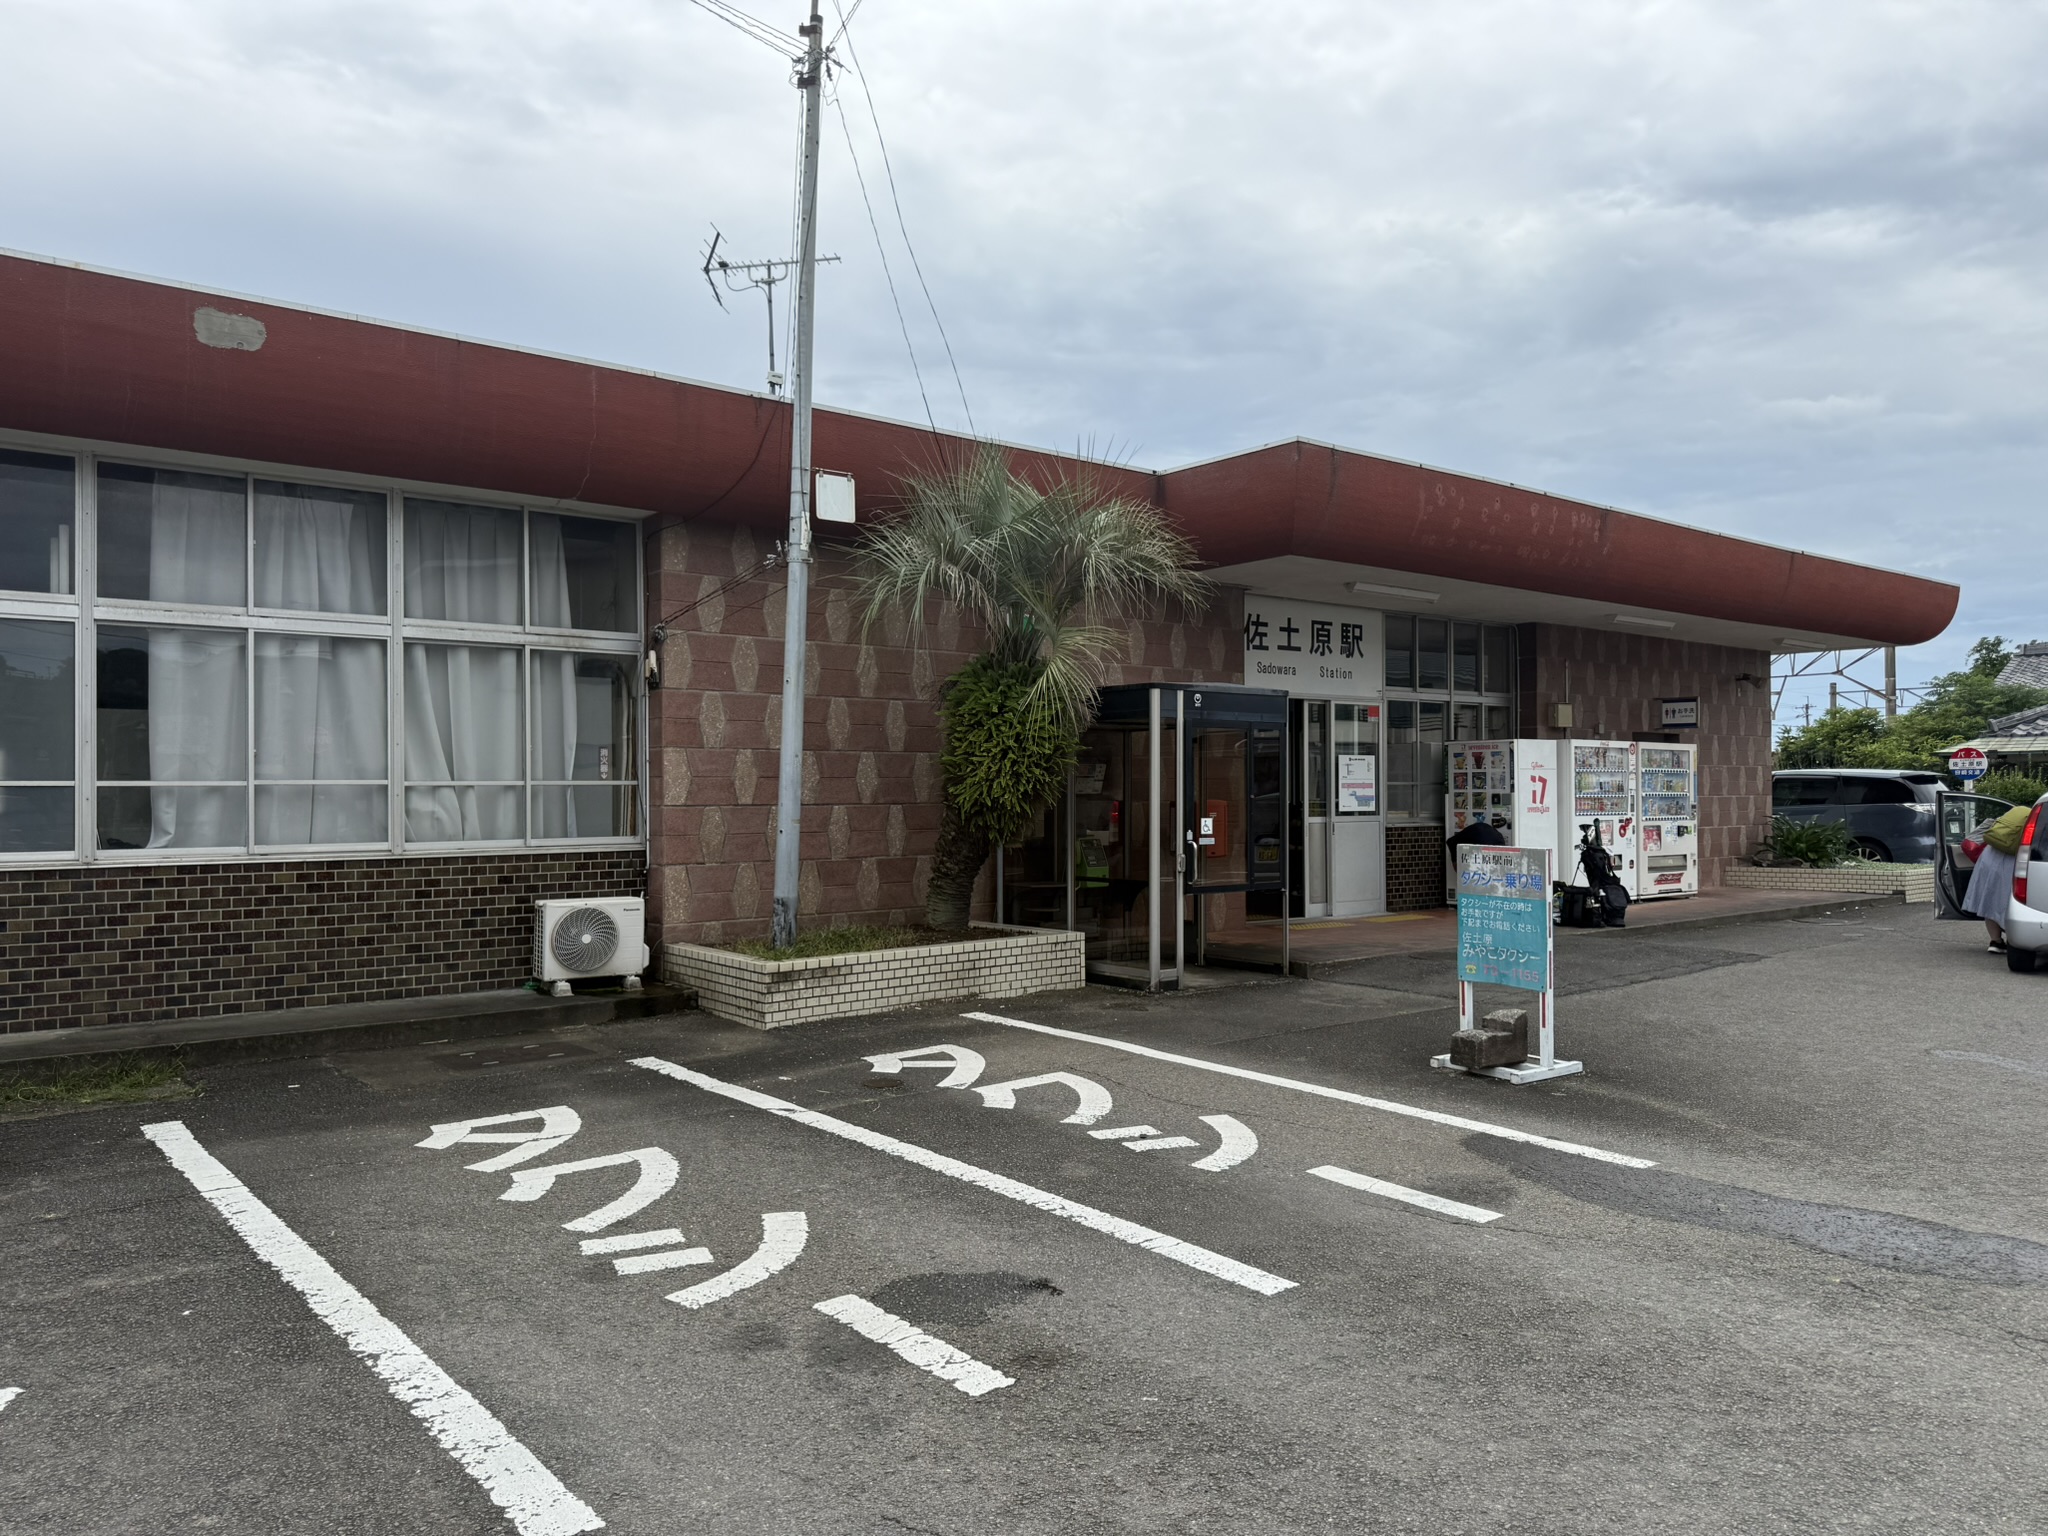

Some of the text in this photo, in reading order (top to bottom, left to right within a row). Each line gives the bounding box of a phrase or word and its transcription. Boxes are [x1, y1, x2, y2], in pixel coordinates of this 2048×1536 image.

[1244, 613, 1364, 658] 佐土原駅
[1256, 661, 1353, 680] Sadowara Station
[1460, 853, 1513, 867] 佐土原駅前
[1461, 872, 1542, 891] タクシー乗り場
[1461, 898, 1533, 912] タクシーが不在の時は
[1461, 908, 1504, 920] お手数ですが
[1461, 918, 1541, 934] 下記までお電話ください
[1462, 931, 1493, 945] 佐土原
[1462, 944, 1541, 963] みやこタクシー
